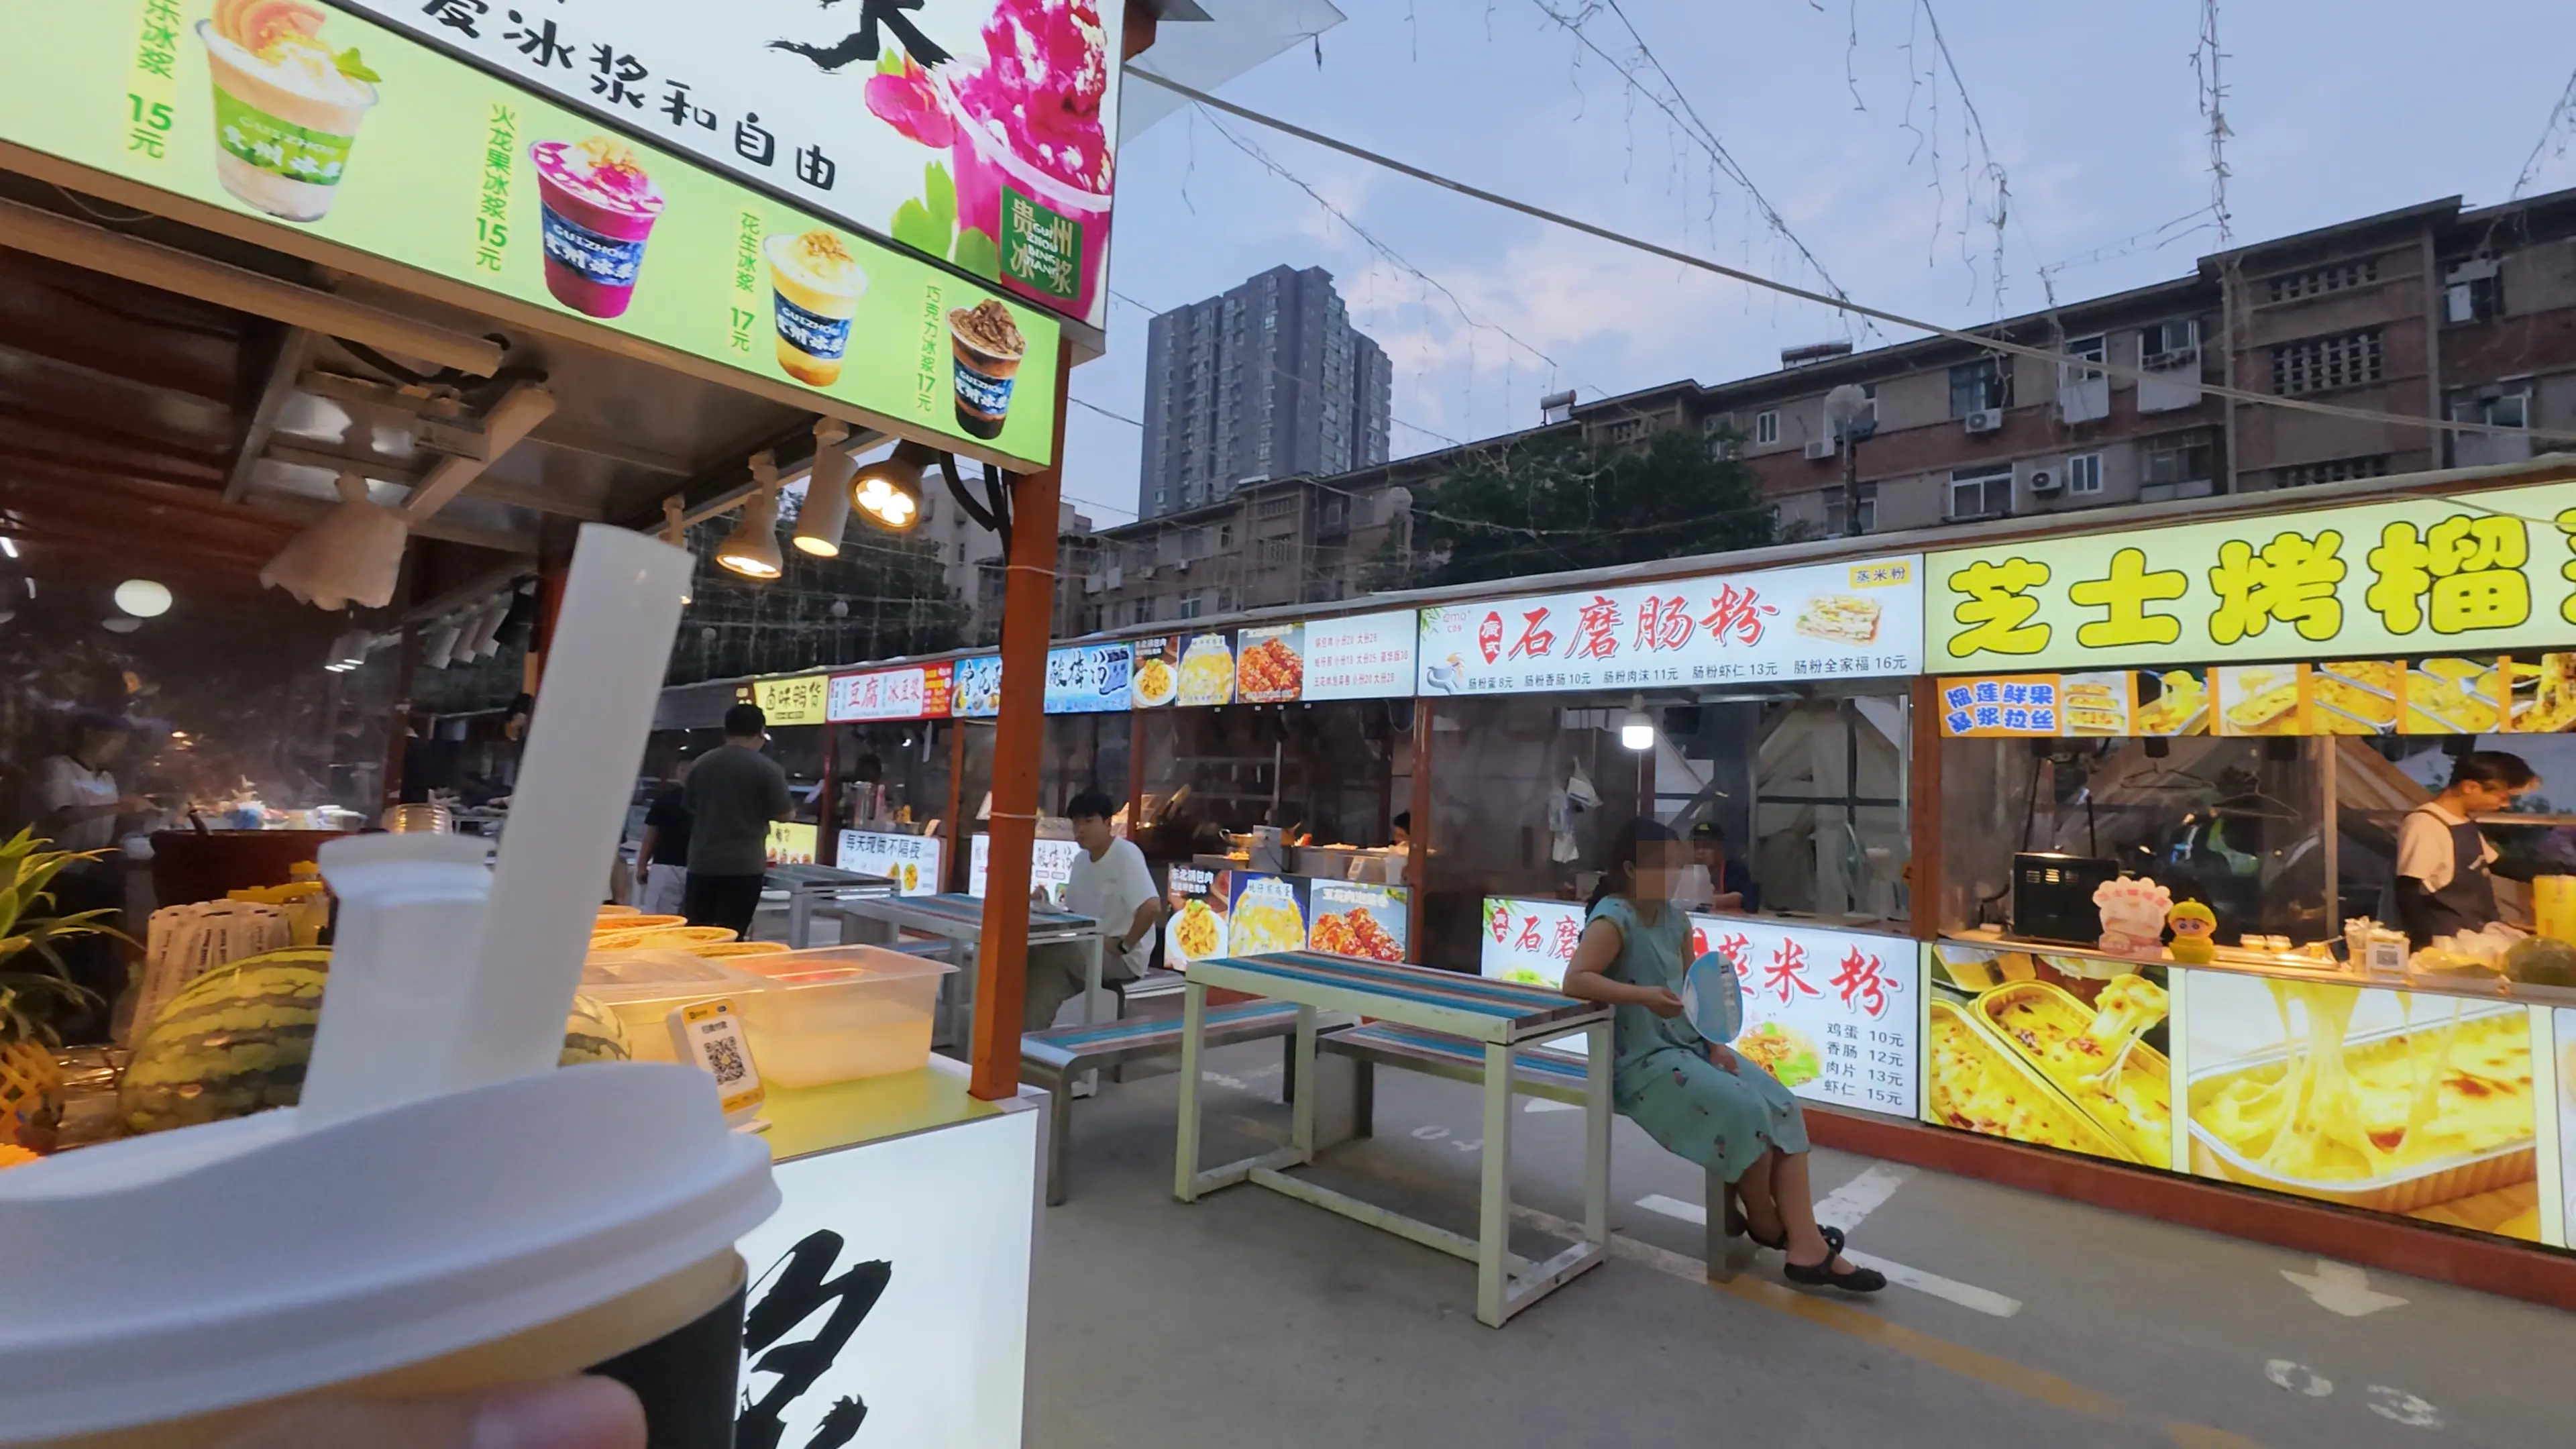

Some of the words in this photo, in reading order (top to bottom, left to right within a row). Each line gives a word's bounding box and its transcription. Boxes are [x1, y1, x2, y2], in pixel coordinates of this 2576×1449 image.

[480, 103, 516, 221] 火龙果冰浆
[553, 224, 631, 260] GUIZHOU
[736, 212, 761, 293] 花生冰浆
[782, 307, 839, 335] GUIZHOU
[1856, 567, 1907, 584] 蒸米粉
[1946, 508, 2576, 658] 芝士烤榴
[1508, 582, 1778, 661] 石磨肠粉
[1524, 673, 1566, 688] 肠粉香肠
[1569, 672, 1592, 685] 10元
[1654, 667, 1679, 681] 11元
[1692, 663, 1746, 680] 肠粉虾仁
[1749, 661, 1778, 677] 13元
[1794, 656, 1870, 675] 肠粉全家福
[1875, 654, 1909, 671] 16元
[1827, 1022, 1860, 1040] 鸡蛋
[1869, 1030, 1904, 1048] 10元
[1827, 1041, 1858, 1059] 香肠
[1868, 1049, 1904, 1068] 12元
[1825, 1061, 1856, 1078] 肉片
[1868, 1068, 1904, 1087] 13元
[1824, 1079, 1856, 1097] 虾仁
[1867, 1087, 1903, 1106] 15元
